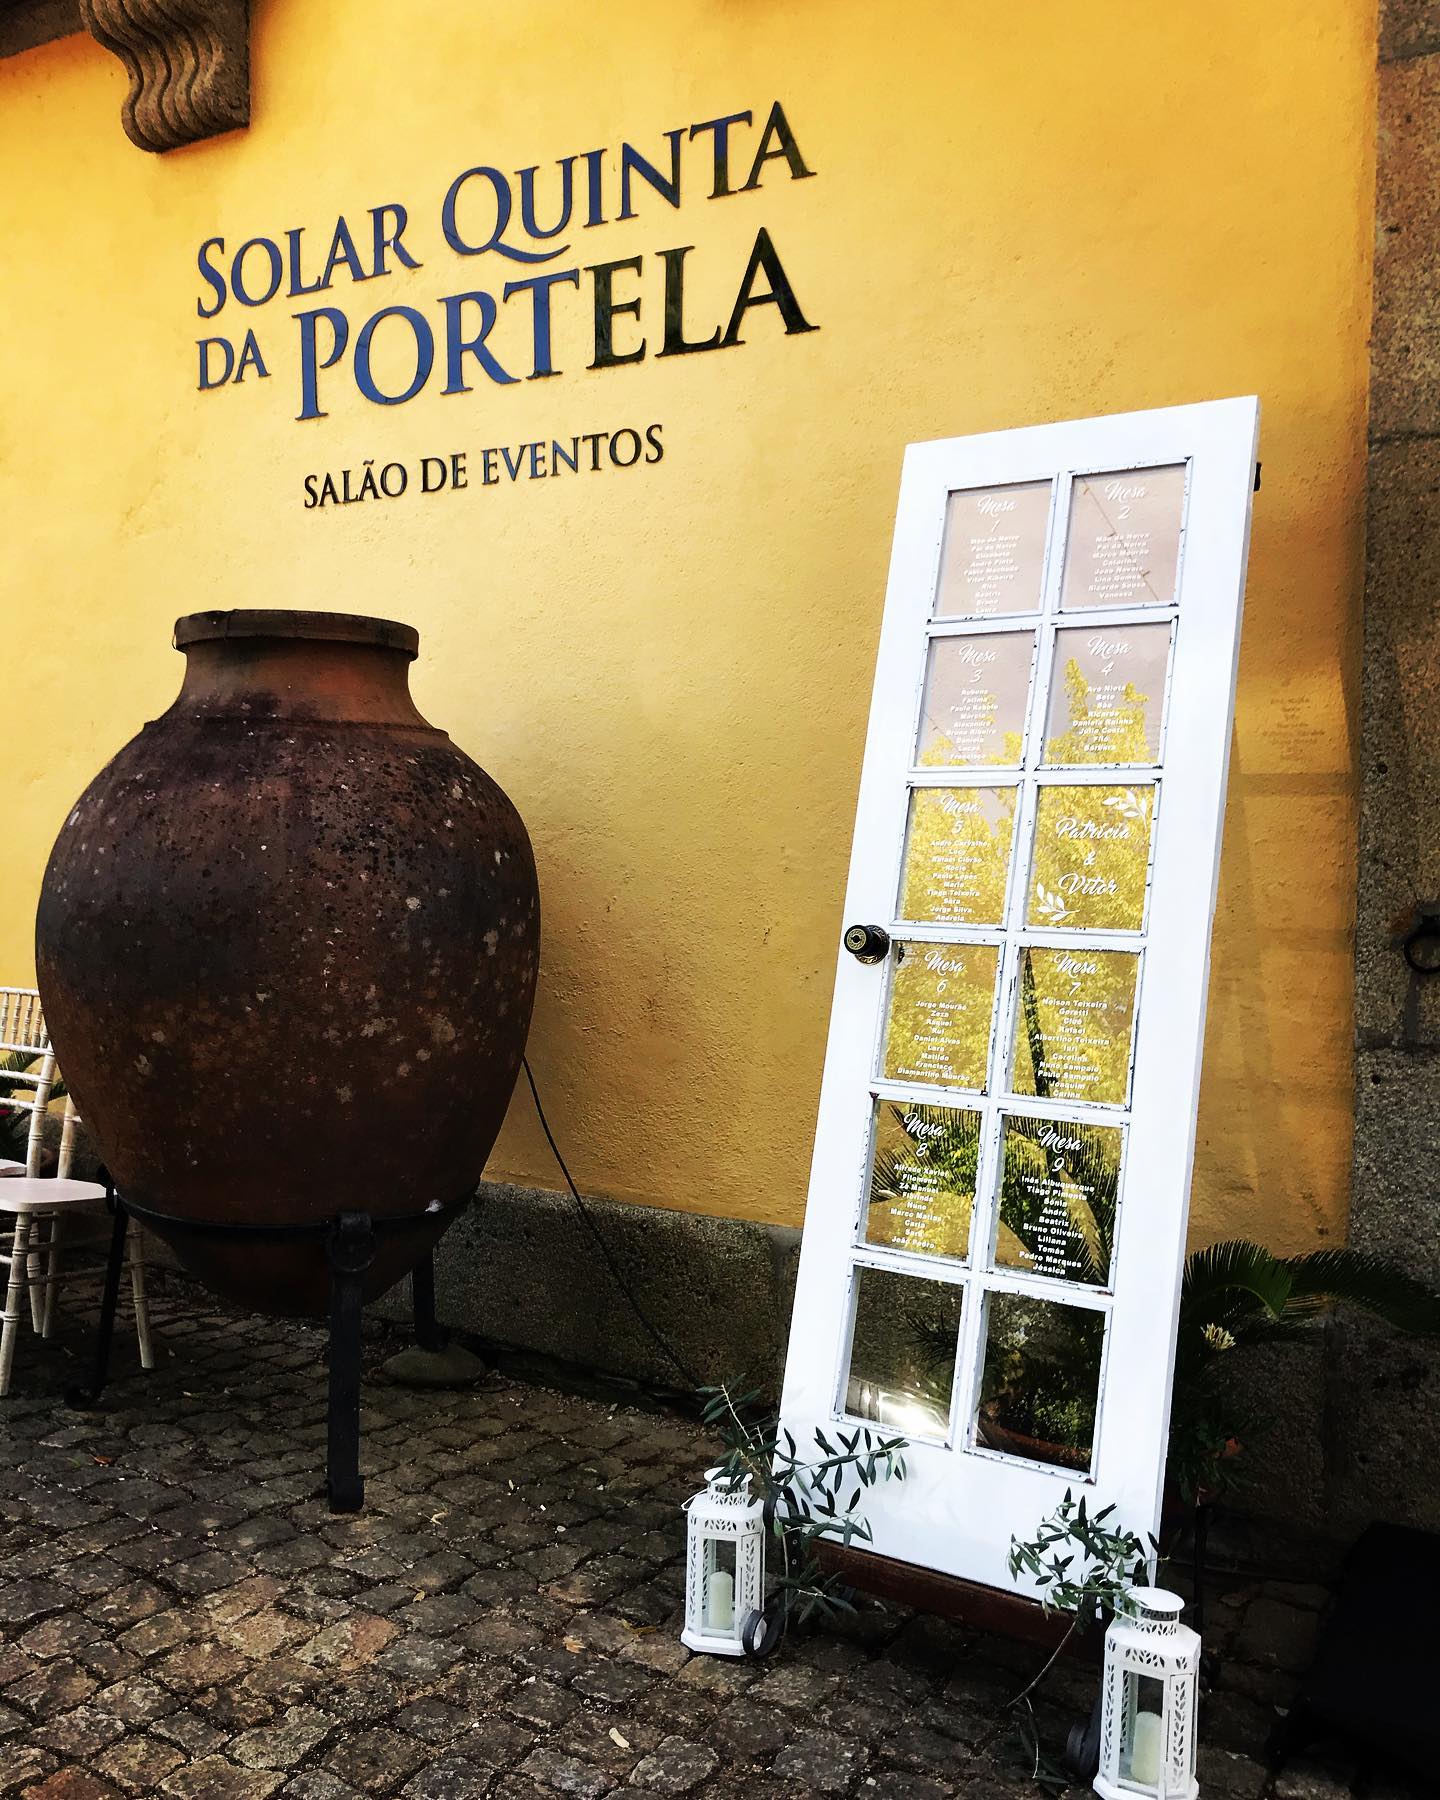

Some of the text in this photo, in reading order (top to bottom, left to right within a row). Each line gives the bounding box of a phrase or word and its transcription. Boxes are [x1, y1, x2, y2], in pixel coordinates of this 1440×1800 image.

[197, 100, 818, 319] SOLAR QUINTA
[196, 226, 821, 422] DA PORTELA
[303, 423, 665, 510] SALÃO DE EVENTOS
[1105, 480, 1145, 503] Mesa
[977, 495, 1016, 517] Mesa
[1087, 636, 1131, 660] Mesa
[959, 644, 996, 667] Mesa
[1102, 661, 1114, 676] 4
[969, 669, 982, 683] 3
[940, 794, 981, 817] Mesa
[951, 820, 964, 834] 5
[924, 950, 966, 976] Mesa
[1053, 953, 1101, 979] Mesa
[937, 979, 948, 993] 6
[1068, 981, 1082, 996] 7
[1042, 998, 1108, 1009] Nelson Teixeira
[1059, 1008, 1088, 1016] Goretti
[1034, 1033, 1109, 1045] Albertino Teixeira
[1052, 1053, 1088, 1062] Carolina
[897, 1067, 939, 1078] Diamantino
[916, 1061, 953, 1071] Francisco
[1063, 1064, 1099, 1073] Sampaio
[1038, 1070, 1099, 1082] Paulo Sampaio
[1049, 1081, 1085, 1090] Joaquim
[1053, 1090, 1081, 1099] Carina
[903, 1112, 948, 1140] Mesa
[1037, 1124, 1085, 1153] Mesa
[916, 1143, 928, 1157] 8
[893, 1163, 948, 1177] Alfredo Xavier
[1052, 1157, 1065, 1172] 9
[903, 1174, 937, 1185] Filomena
[1041, 1178, 1095, 1193] Albuquerque
[912, 1184, 939, 1194] Manuel
[1026, 1185, 1088, 1201] Tiago Pimenta
[907, 1201, 927, 1210] Nuno
[891, 1208, 942, 1223] Marco Matias
[1039, 1215, 1069, 1227] Beatriz
[905, 1219, 925, 1228] Carla
[1023, 1222, 1084, 1239] Bruno Oliveira
[891, 1236, 935, 1249] João Pedro
[1038, 1235, 1067, 1246] Liliana
[1019, 1251, 1082, 1268] Pedro Marques
